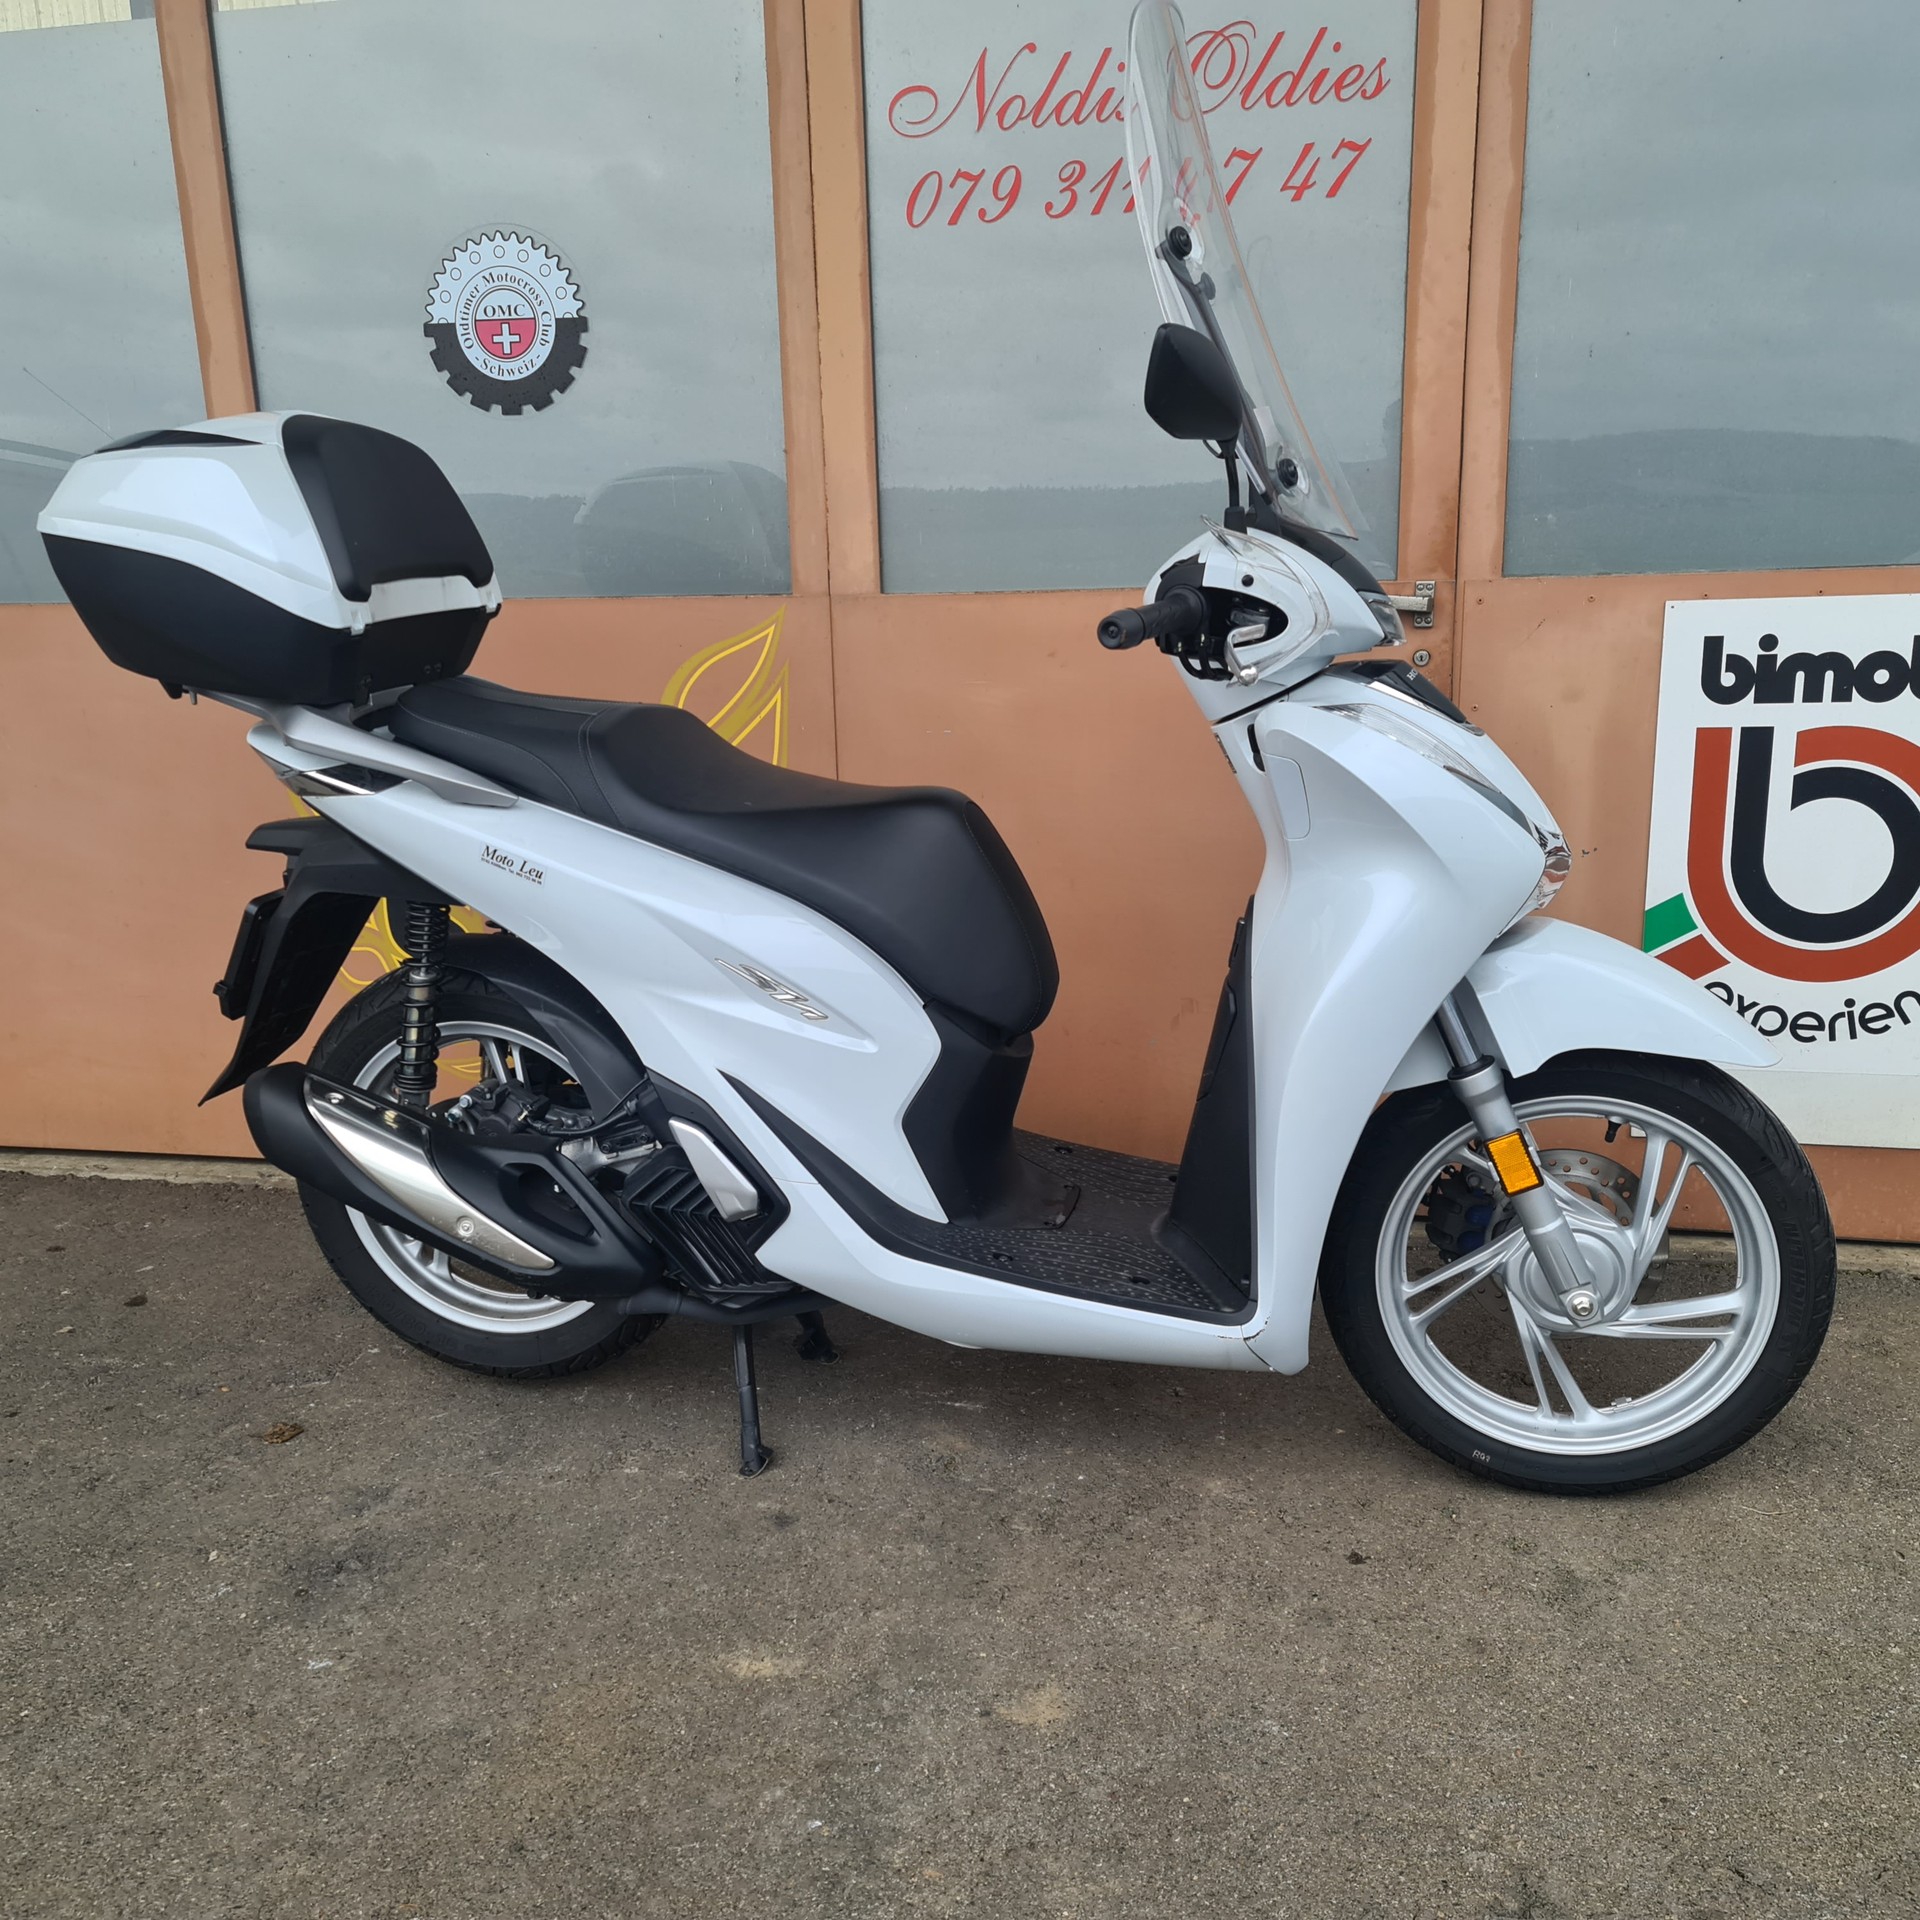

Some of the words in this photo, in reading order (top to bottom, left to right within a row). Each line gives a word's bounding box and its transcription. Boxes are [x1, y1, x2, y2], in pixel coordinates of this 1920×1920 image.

[905, 163, 1023, 229] 079
[1279, 136, 1373, 203] 47
[459, 283, 480, 350] Oldtimer
[481, 271, 545, 307] Motocross
[538, 310, 553, 347] Club
[483, 303, 526, 318] OMC
[481, 845, 514, 868] Moto
[519, 860, 544, 880] Leu
